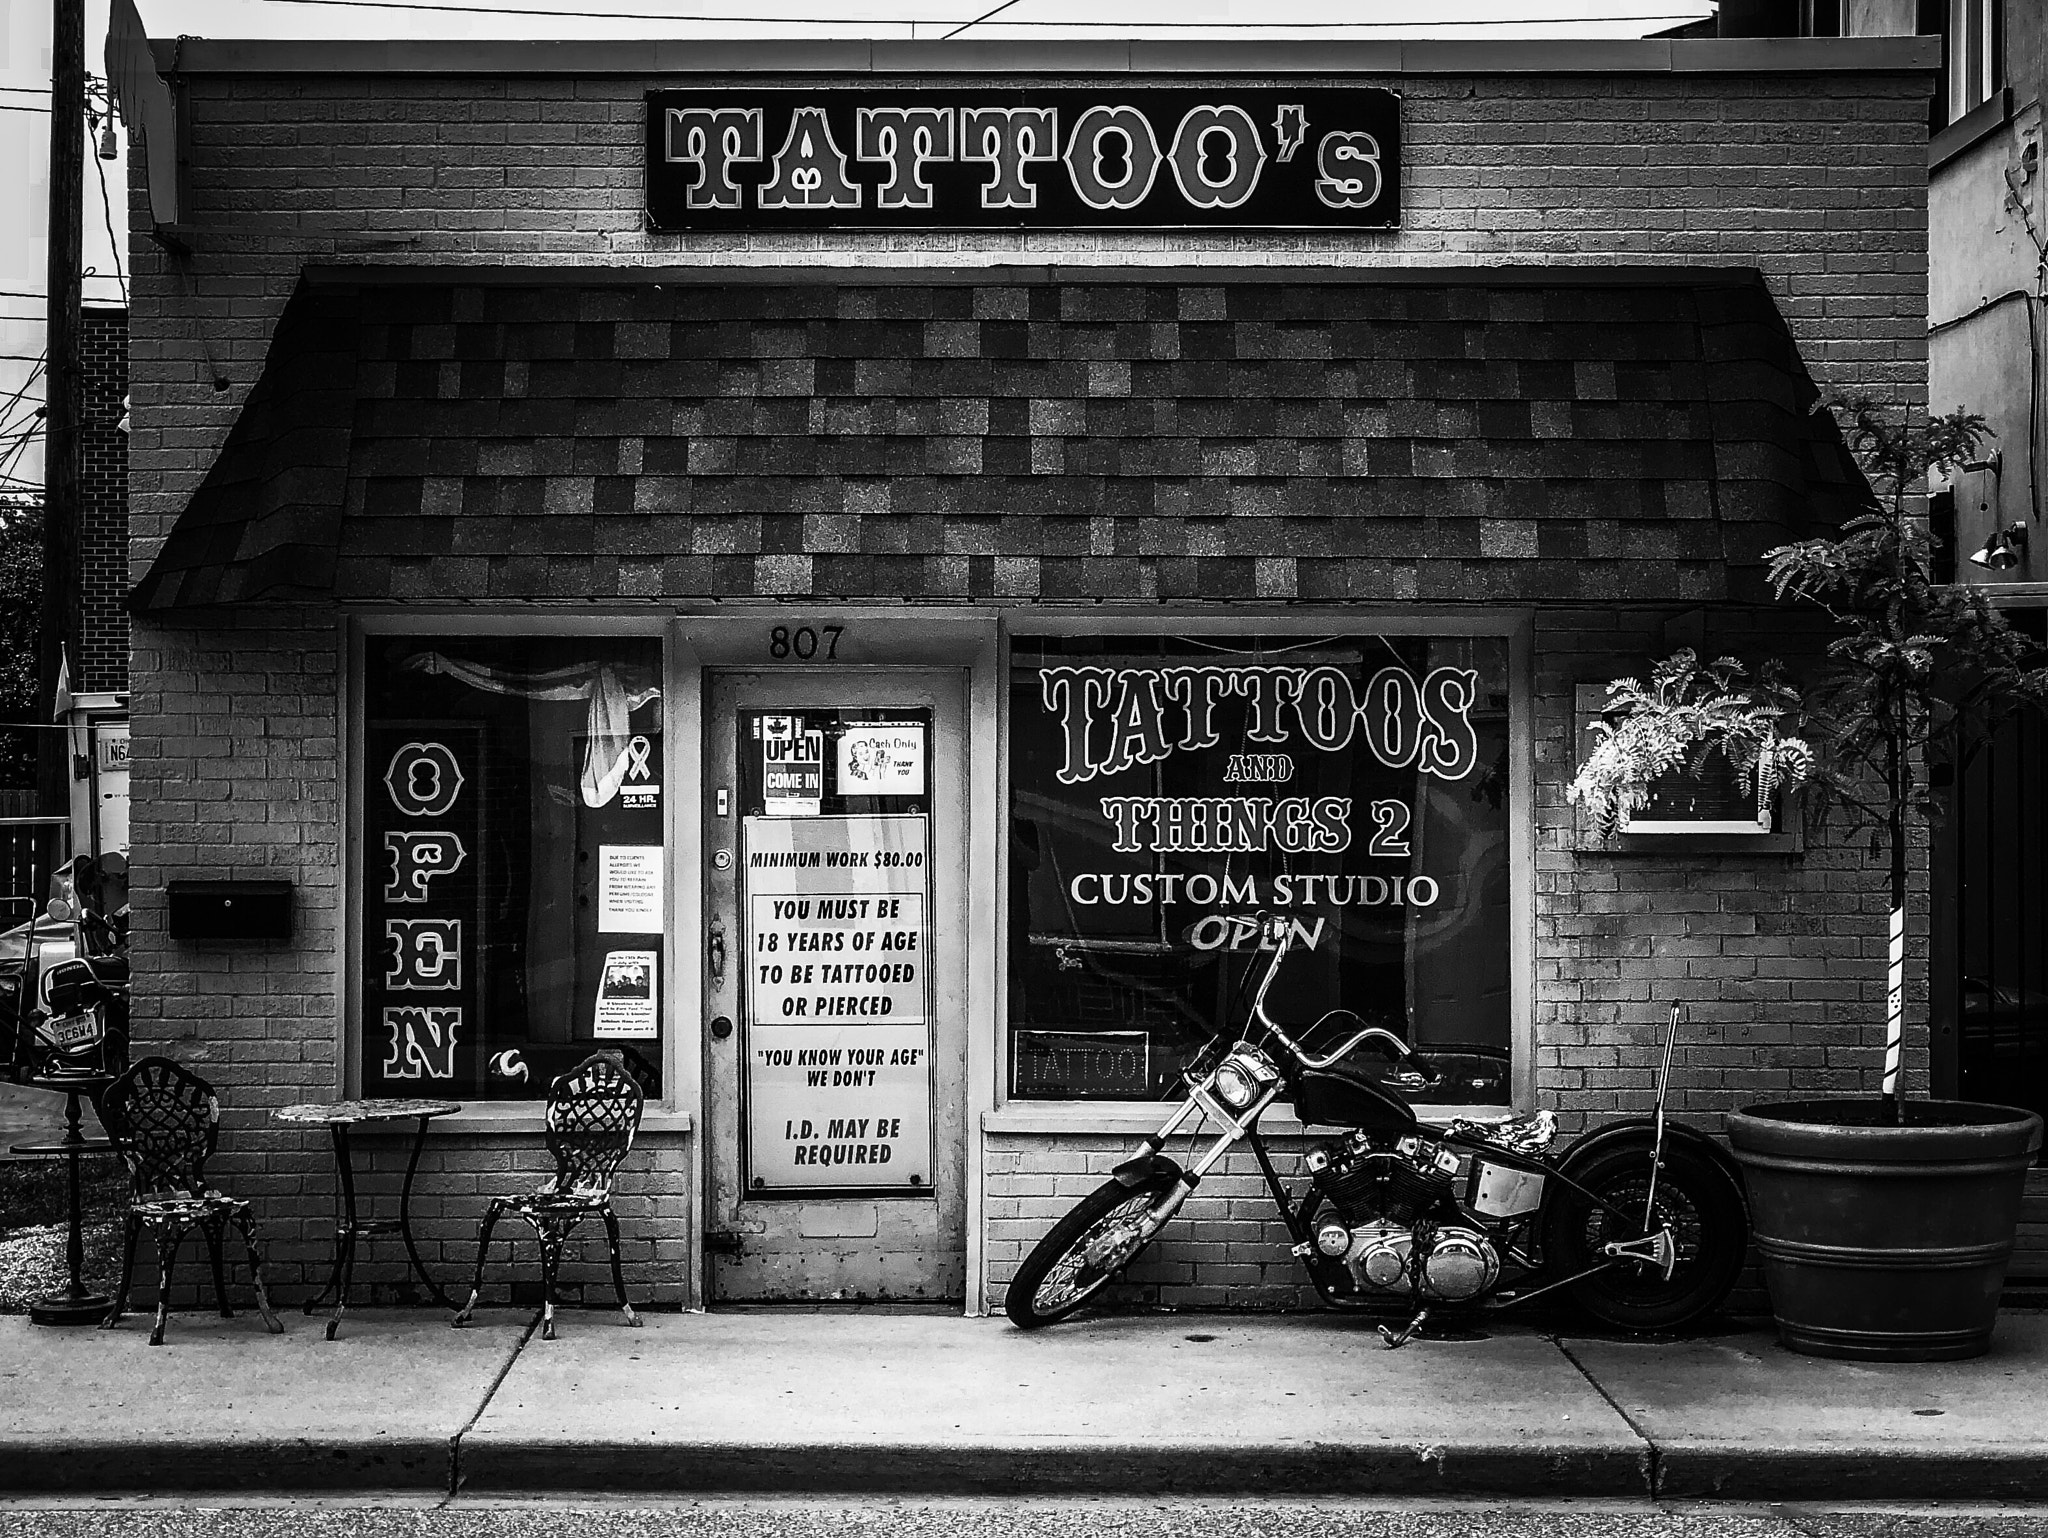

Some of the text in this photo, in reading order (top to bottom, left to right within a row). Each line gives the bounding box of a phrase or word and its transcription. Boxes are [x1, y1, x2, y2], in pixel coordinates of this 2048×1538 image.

[665, 104, 1382, 208] TATTOO's
[769, 626, 845, 660] 807
[1040, 666, 1478, 784] TATTOOS
[765, 735, 821, 761] OPEN
[869, 737, 917, 750] Cash Only
[893, 760, 914, 768] THANK
[1223, 754, 1295, 783] AND
[767, 773, 819, 789] COME IN
[623, 795, 637, 804] 24
[1100, 797, 1412, 857] THINGS 2
[750, 850, 923, 869] MINIMUM WORK $80.00
[1070, 873, 1440, 907] CUSTOM STUDIO
[383, 742, 467, 1079] OPEN
[773, 899, 900, 920] YOU MUST BE
[757, 931, 917, 952] 18 YEARS OF AGE
[56, 964, 86, 975] HONDA
[759, 964, 915, 984] TO BE TATTOOED
[782, 996, 892, 1017] OR PIERCED
[757, 1049, 924, 1067] "YOU KNOW YOUR AGE"
[1027, 1047, 1138, 1082] TATTOO
[806, 1070, 876, 1087] WE DON'T
[785, 1119, 900, 1140] I.D. MAY BE
[793, 1145, 892, 1167] REQUIRED
